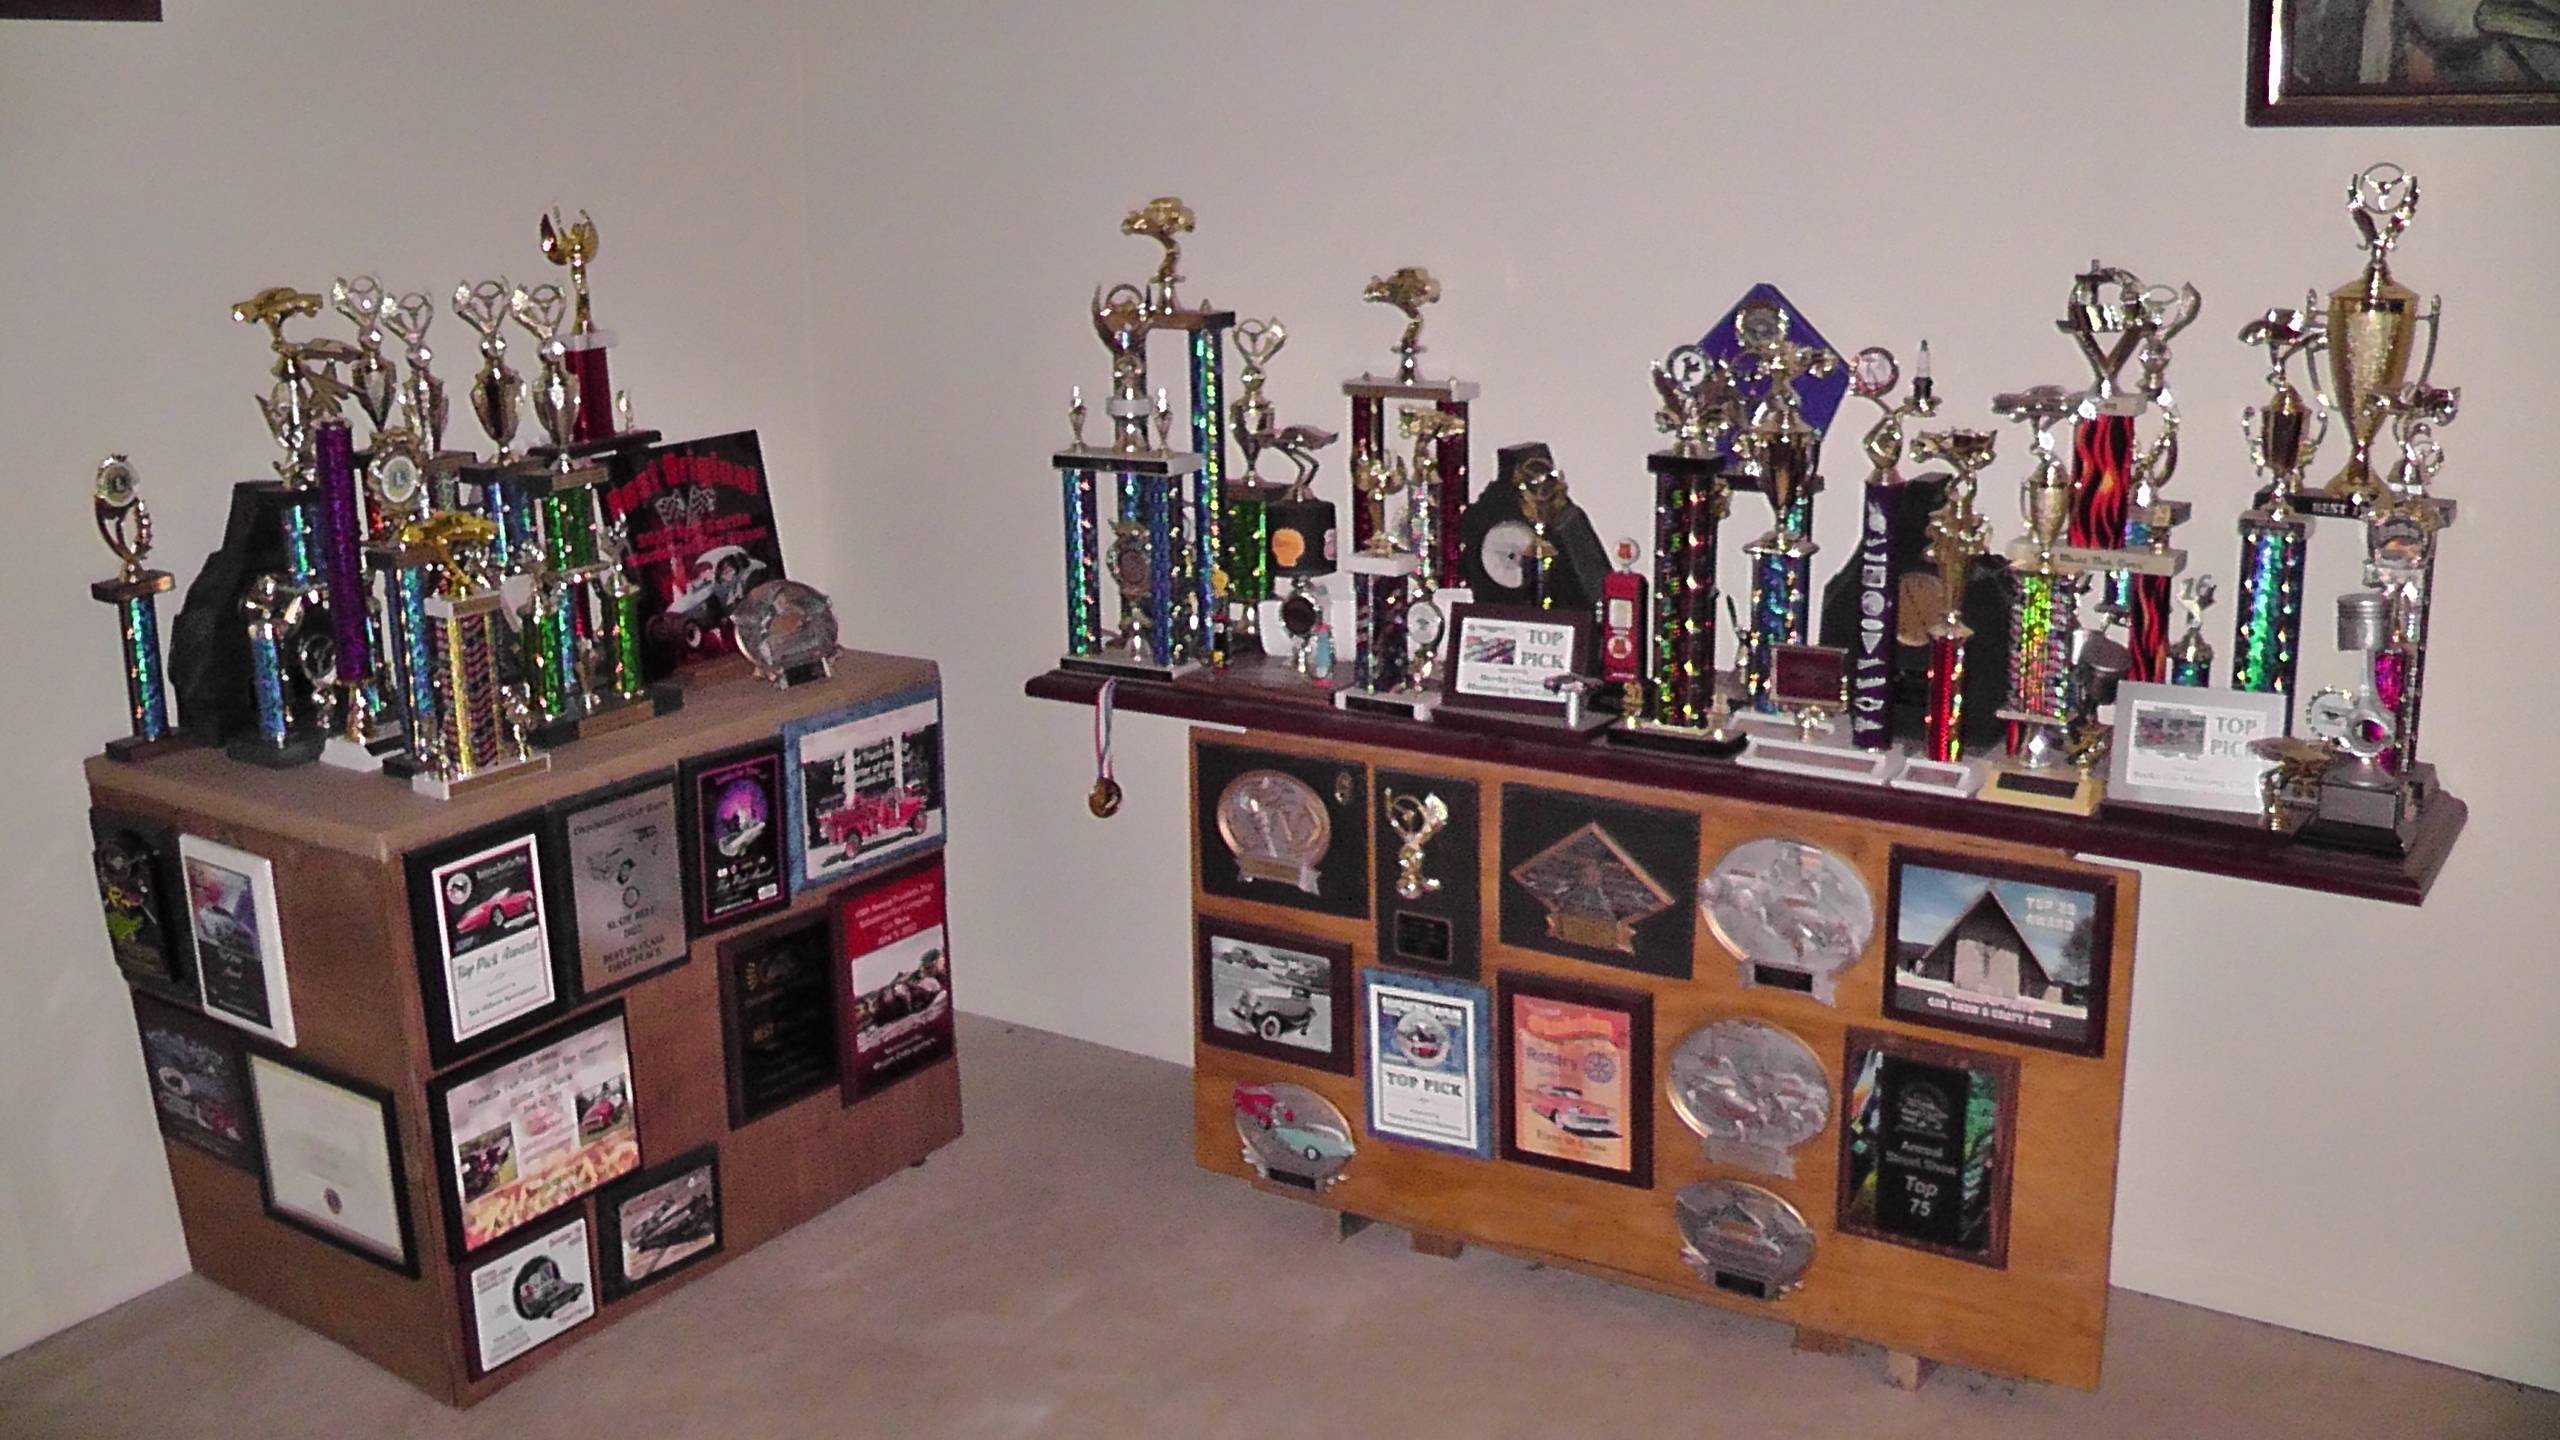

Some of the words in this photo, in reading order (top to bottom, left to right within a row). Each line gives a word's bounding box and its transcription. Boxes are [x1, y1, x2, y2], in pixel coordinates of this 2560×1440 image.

[1529, 629, 1564, 646] TOP
[1520, 651, 1564, 669] PICK
[2216, 716, 2258, 736] TOP
[2210, 739, 2257, 758] PIC
[1526, 1046, 1578, 1072] Rotary
[1385, 1071, 1419, 1088] TOP
[1423, 1078, 1464, 1098] PICK
[1905, 1174, 1939, 1199] Top
[1909, 1197, 1931, 1217] 75
